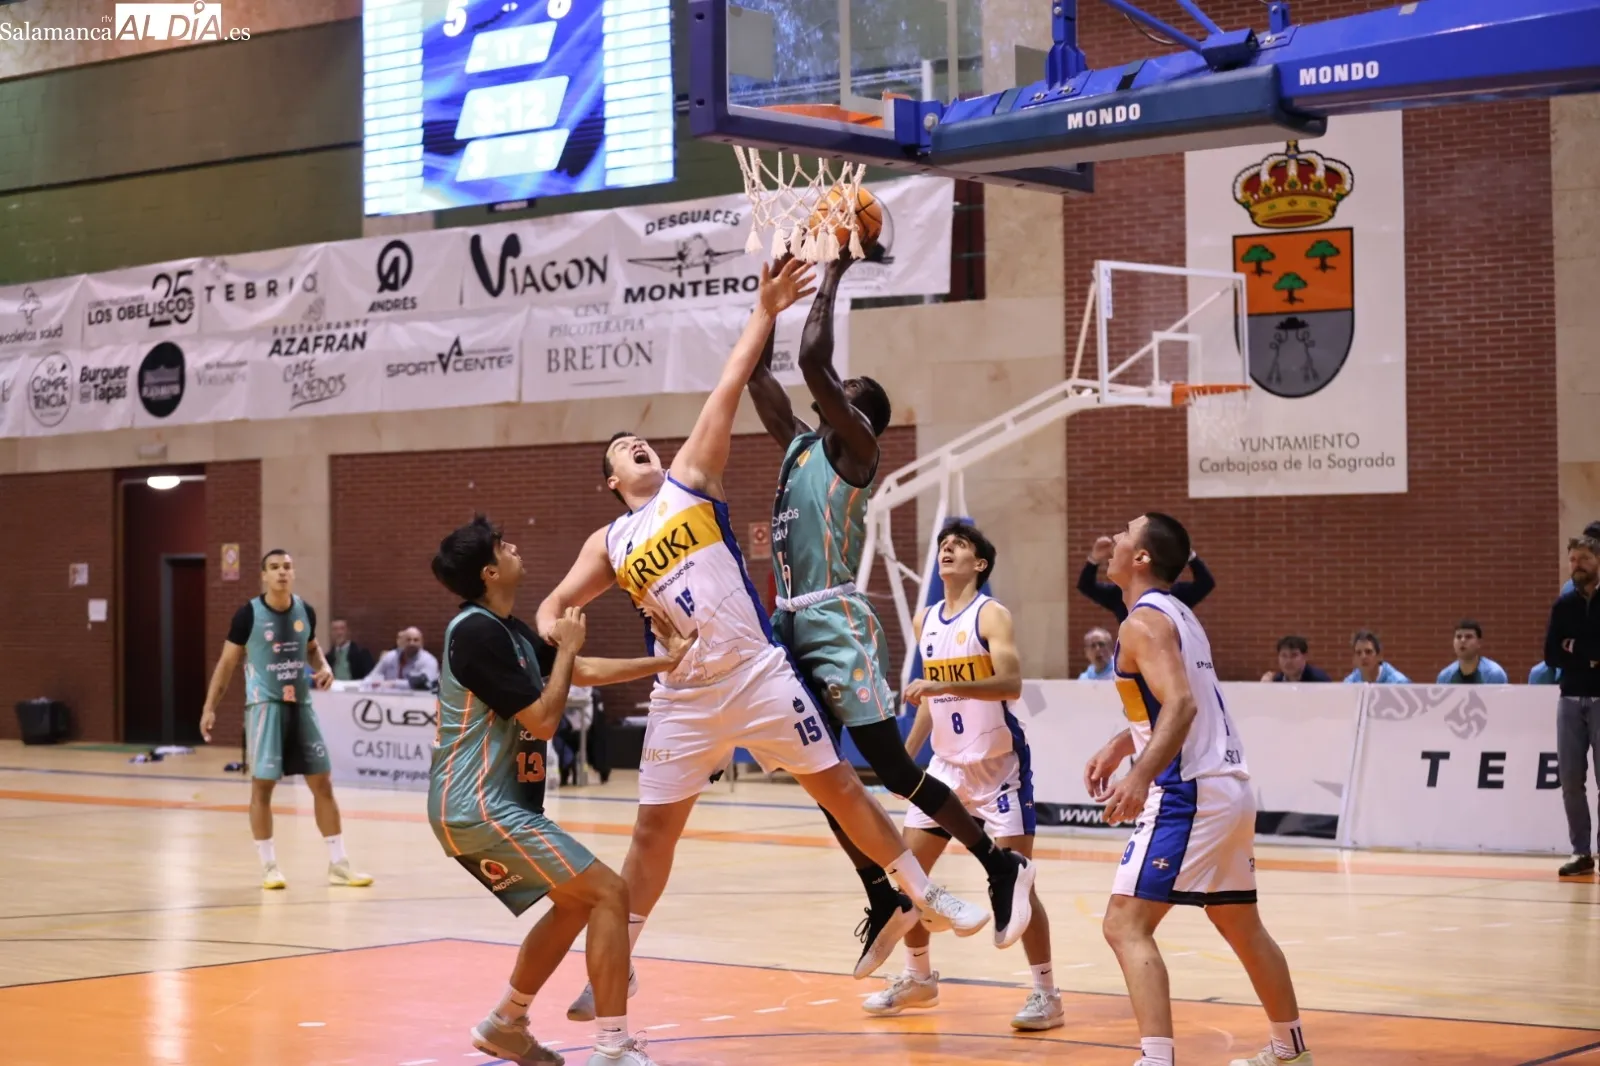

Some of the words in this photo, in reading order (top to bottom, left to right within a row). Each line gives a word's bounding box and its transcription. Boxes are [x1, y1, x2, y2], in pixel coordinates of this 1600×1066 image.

[1298, 60, 1381, 87] MONDO
[1066, 102, 1142, 130] MONDO
[644, 208, 742, 236] DESGUACES
[469, 232, 609, 298] VIAGON
[622, 273, 761, 306] MONTERO
[87, 308, 113, 327] LOS
[116, 296, 195, 323] OBELISCOS
[267, 331, 367, 357] AZAFRAN
[79, 365, 130, 386] Burguer
[386, 359, 438, 378] SPORT
[452, 354, 514, 373] CENTER
[93, 383, 128, 405] Tapas
[1239, 432, 1361, 453] YUNTAMIENTO
[1198, 455, 1278, 477] Carbajosa
[1283, 454, 1303, 471] de
[1307, 453, 1323, 470] la
[1326, 451, 1396, 473] Sagrada
[793, 716, 823, 746] 15
[951, 712, 964, 735] 8
[352, 739, 425, 761] CASTILLA
[516, 752, 545, 782] 13
[1120, 841, 1136, 866] 9
